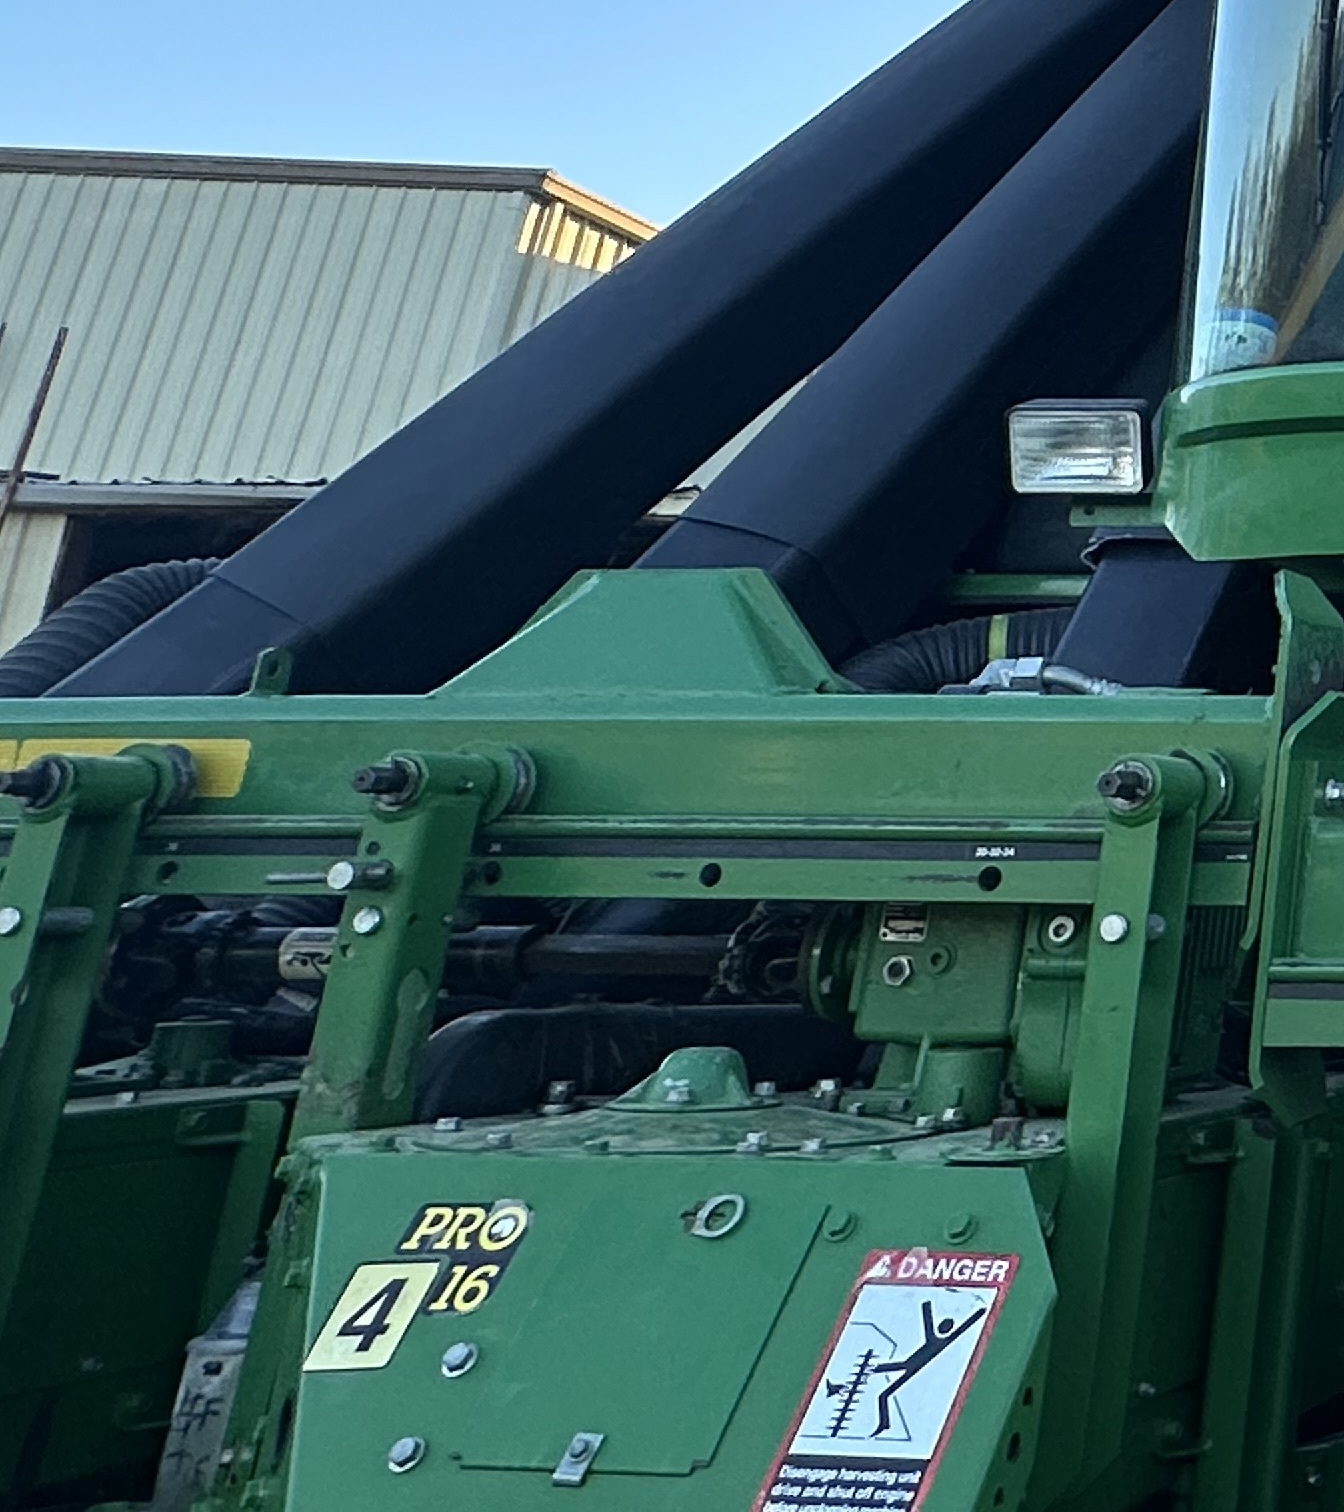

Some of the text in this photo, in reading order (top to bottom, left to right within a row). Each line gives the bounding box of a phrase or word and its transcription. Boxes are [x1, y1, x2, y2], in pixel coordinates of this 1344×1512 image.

[400, 1206, 528, 1251] PRO
[429, 1264, 500, 1312] 16
[897, 1256, 1009, 1282] DANGER
[336, 1277, 409, 1352] 4
[801, 1485, 828, 1498] and
[855, 1487, 875, 1500] off
